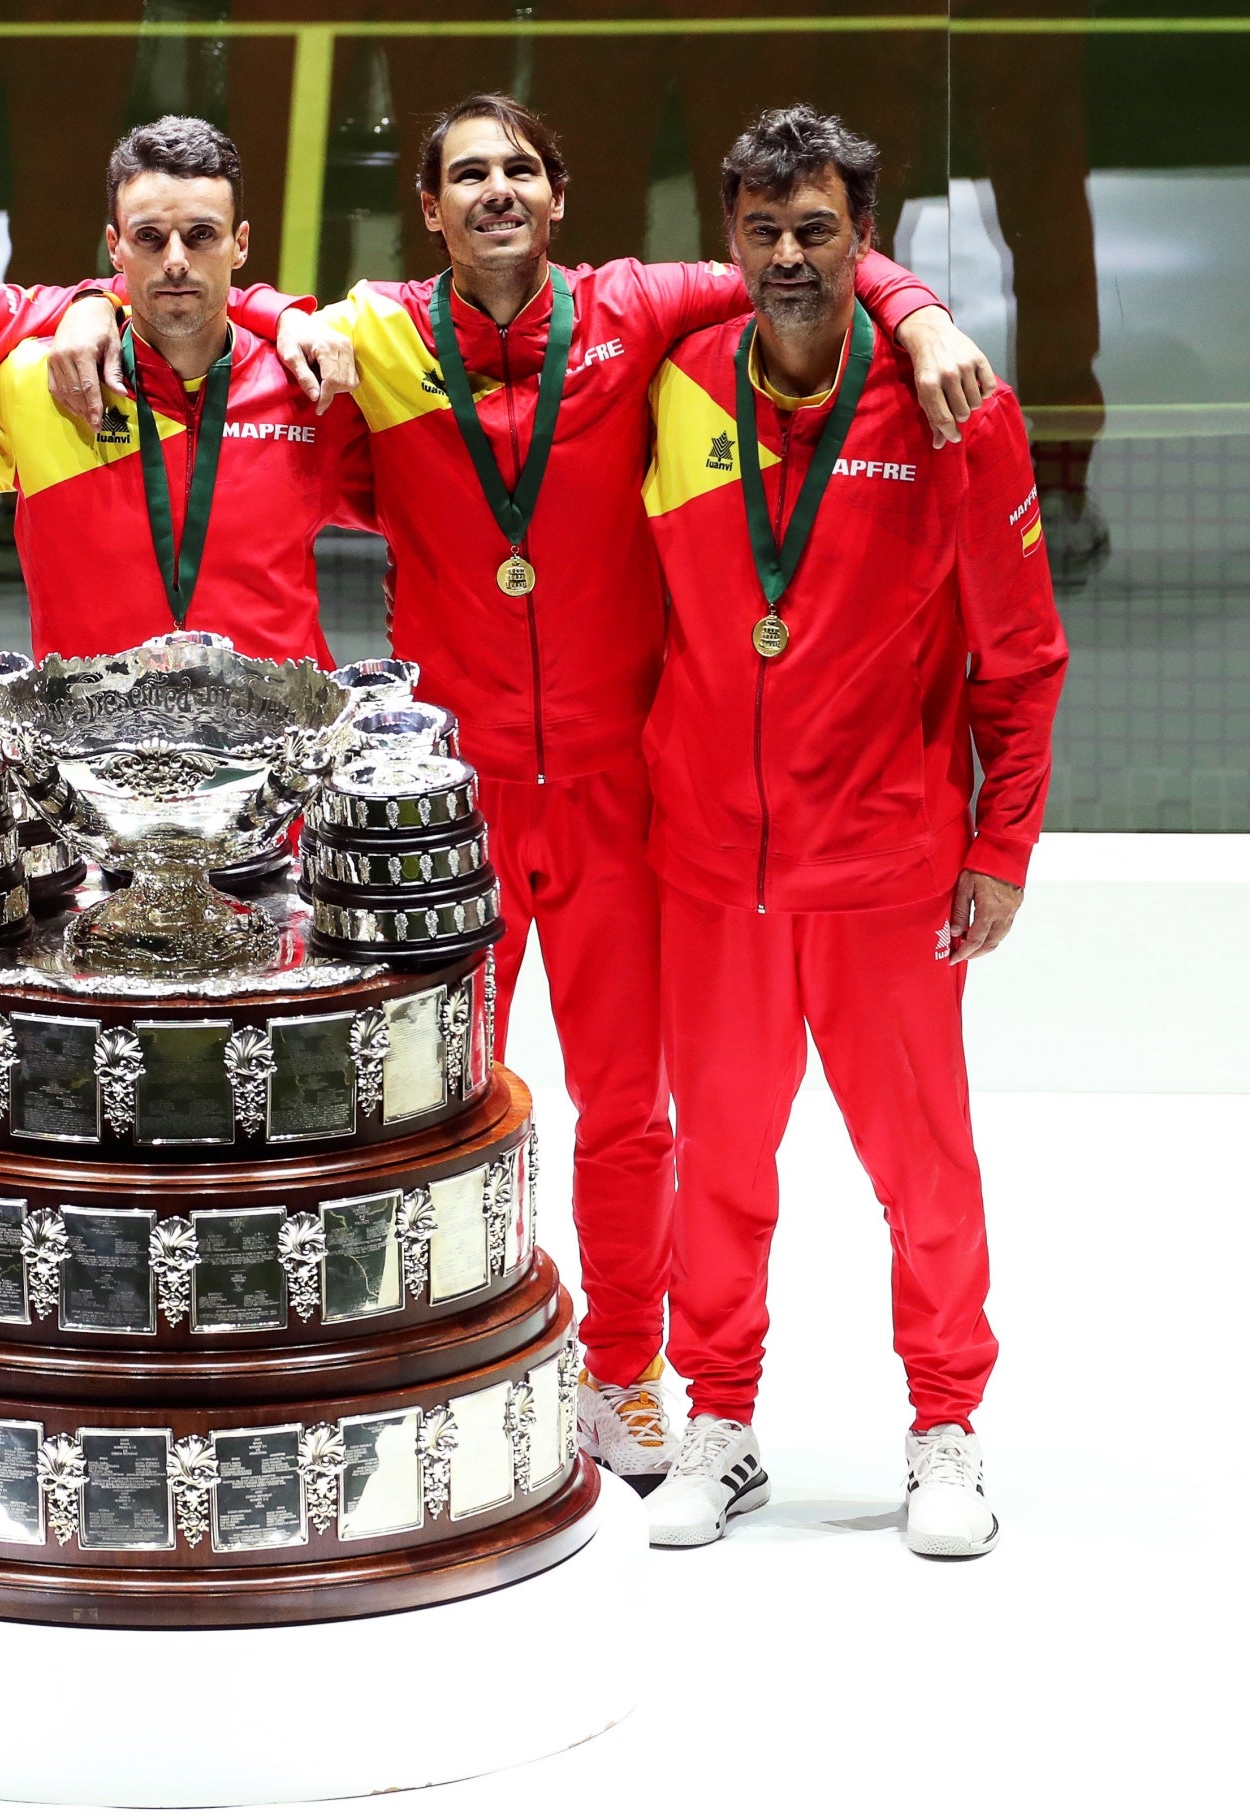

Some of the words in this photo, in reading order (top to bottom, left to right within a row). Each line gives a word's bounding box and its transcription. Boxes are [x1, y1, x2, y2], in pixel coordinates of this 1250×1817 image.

[96, 434, 130, 444] luanvi
[222, 421, 316, 443] MAPFRE
[705, 458, 733, 471] luanvi
[831, 458, 917, 481] APFRE
[1009, 483, 1038, 526] MAPFR
